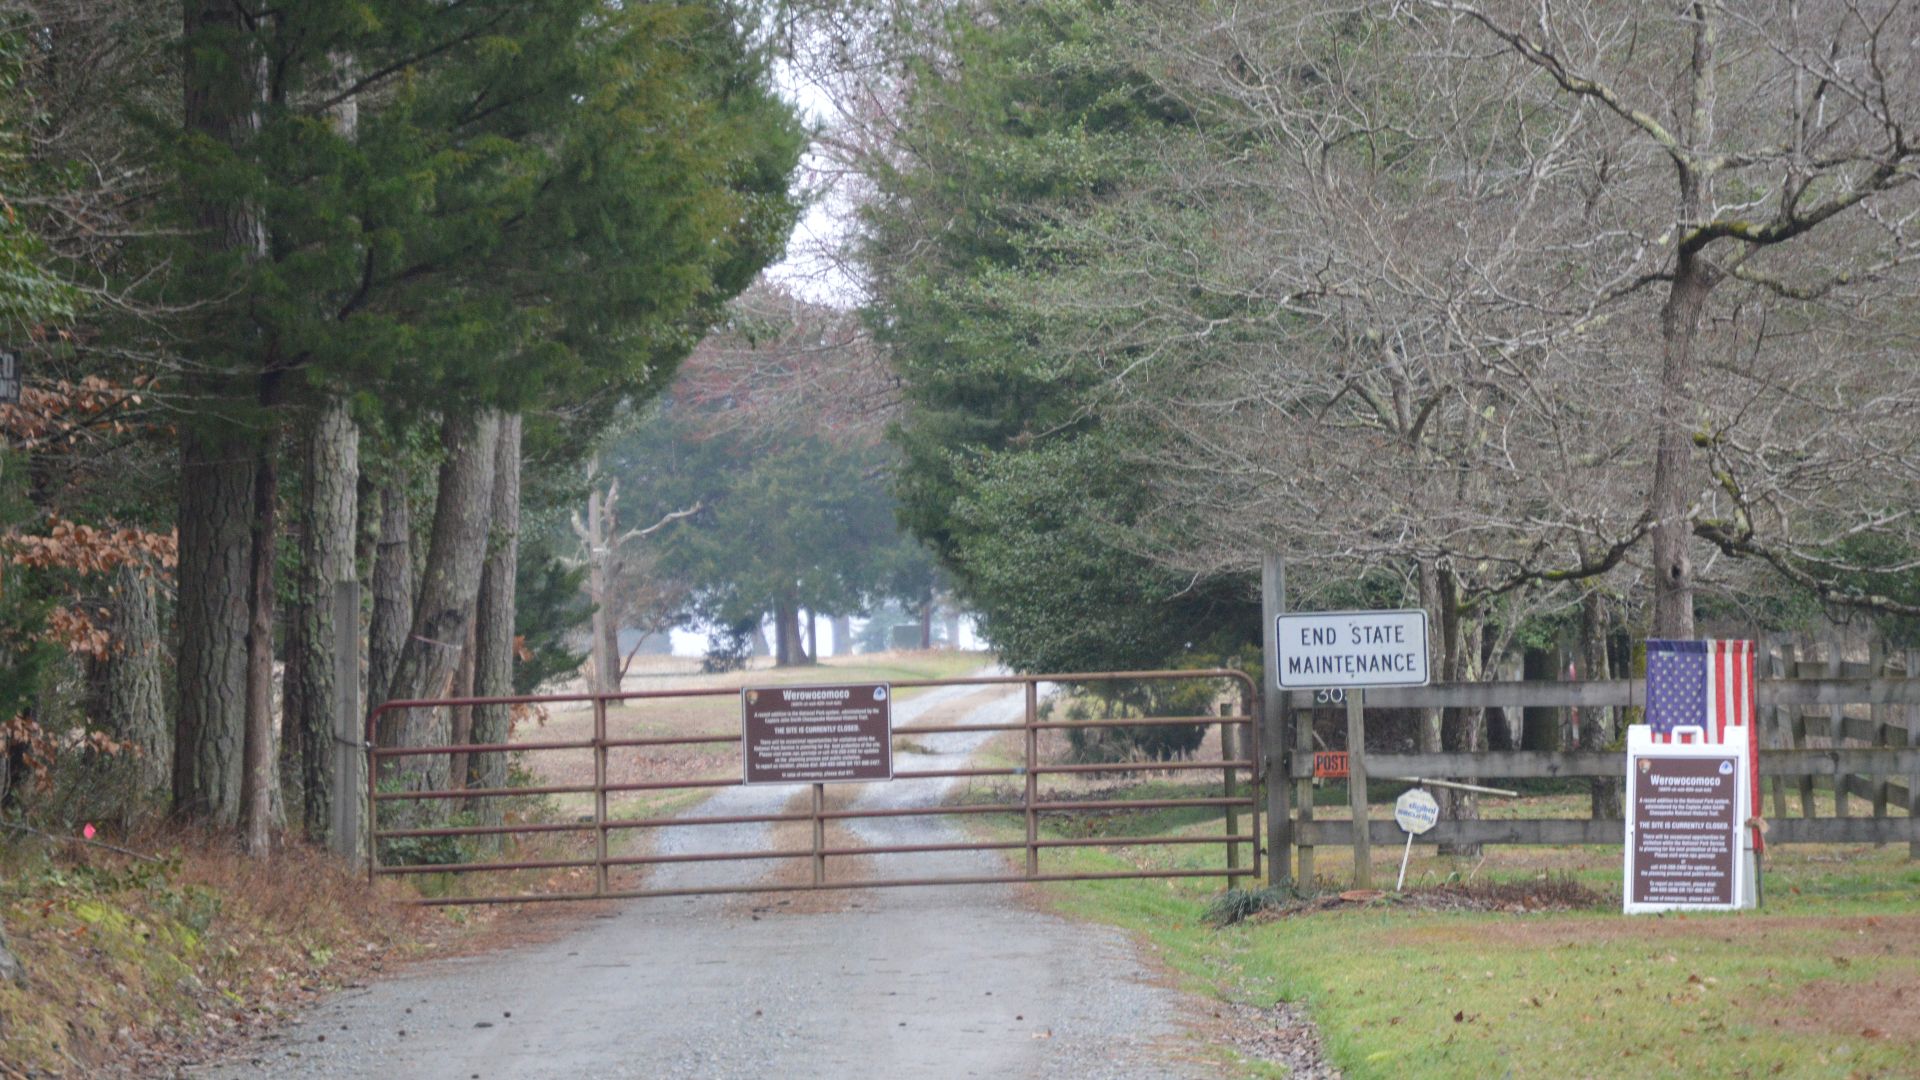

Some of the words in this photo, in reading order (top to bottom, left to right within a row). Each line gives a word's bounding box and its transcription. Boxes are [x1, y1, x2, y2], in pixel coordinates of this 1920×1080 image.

[1301, 627, 1337, 646] END
[1351, 625, 1405, 645] STATE
[1289, 653, 1416, 674] MAINTENANCE
[783, 690, 850, 701] Werowocomoco
[1317, 688, 1347, 704] 30
[774, 727, 785, 735] THE
[799, 726, 804, 734] IS
[805, 725, 836, 733] CURRENTLY
[1316, 755, 1348, 771] POST
[1650, 774, 1721, 786] Werowocomoco
